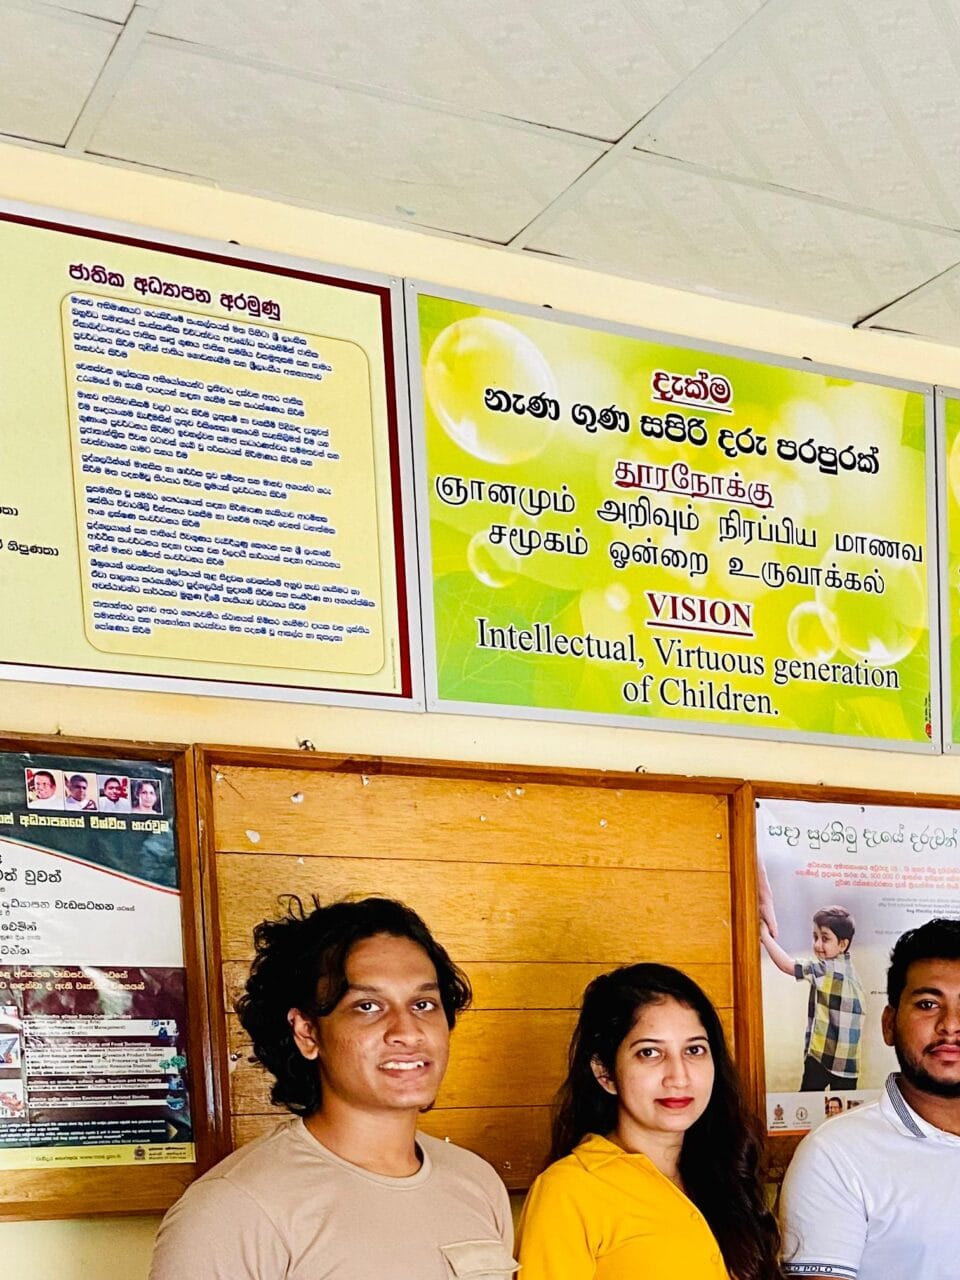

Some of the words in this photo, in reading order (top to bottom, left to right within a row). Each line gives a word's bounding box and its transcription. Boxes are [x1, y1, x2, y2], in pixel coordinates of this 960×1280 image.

[69, 263, 125, 287] ජාතික
[134, 277, 211, 303] අධ්‍යාපන
[220, 293, 281, 321] අරමුණු
[652, 369, 732, 404] දැක්ම
[484, 386, 560, 419] නැණ
[571, 403, 629, 434] ගුණ
[640, 413, 708, 446] සපිරි
[718, 426, 767, 456] දරු
[777, 435, 880, 476] පරපුරක්
[614, 458, 774, 509] தூரநோக்கு
[436, 473, 576, 517] ஞானமும்
[596, 497, 699, 536] அறிவும்
[719, 512, 818, 549] நிரப்பிய
[835, 531, 924, 563] மாணவ
[8, 541, 59, 556] නිපුණතා
[489, 524, 589, 557] சமூகம்
[609, 541, 709, 577] ஒன்றை
[728, 557, 885, 596] உருவாக்கல்
[646, 591, 752, 630] VISION
[477, 618, 645, 669] Intellectual,
[654, 637, 765, 676] Virtuous
[774, 656, 899, 692] generation
[622, 675, 651, 704] of
[659, 680, 779, 717] Children.
[769, 824, 800, 846] සදා
[863, 824, 904, 847] දැයේ
